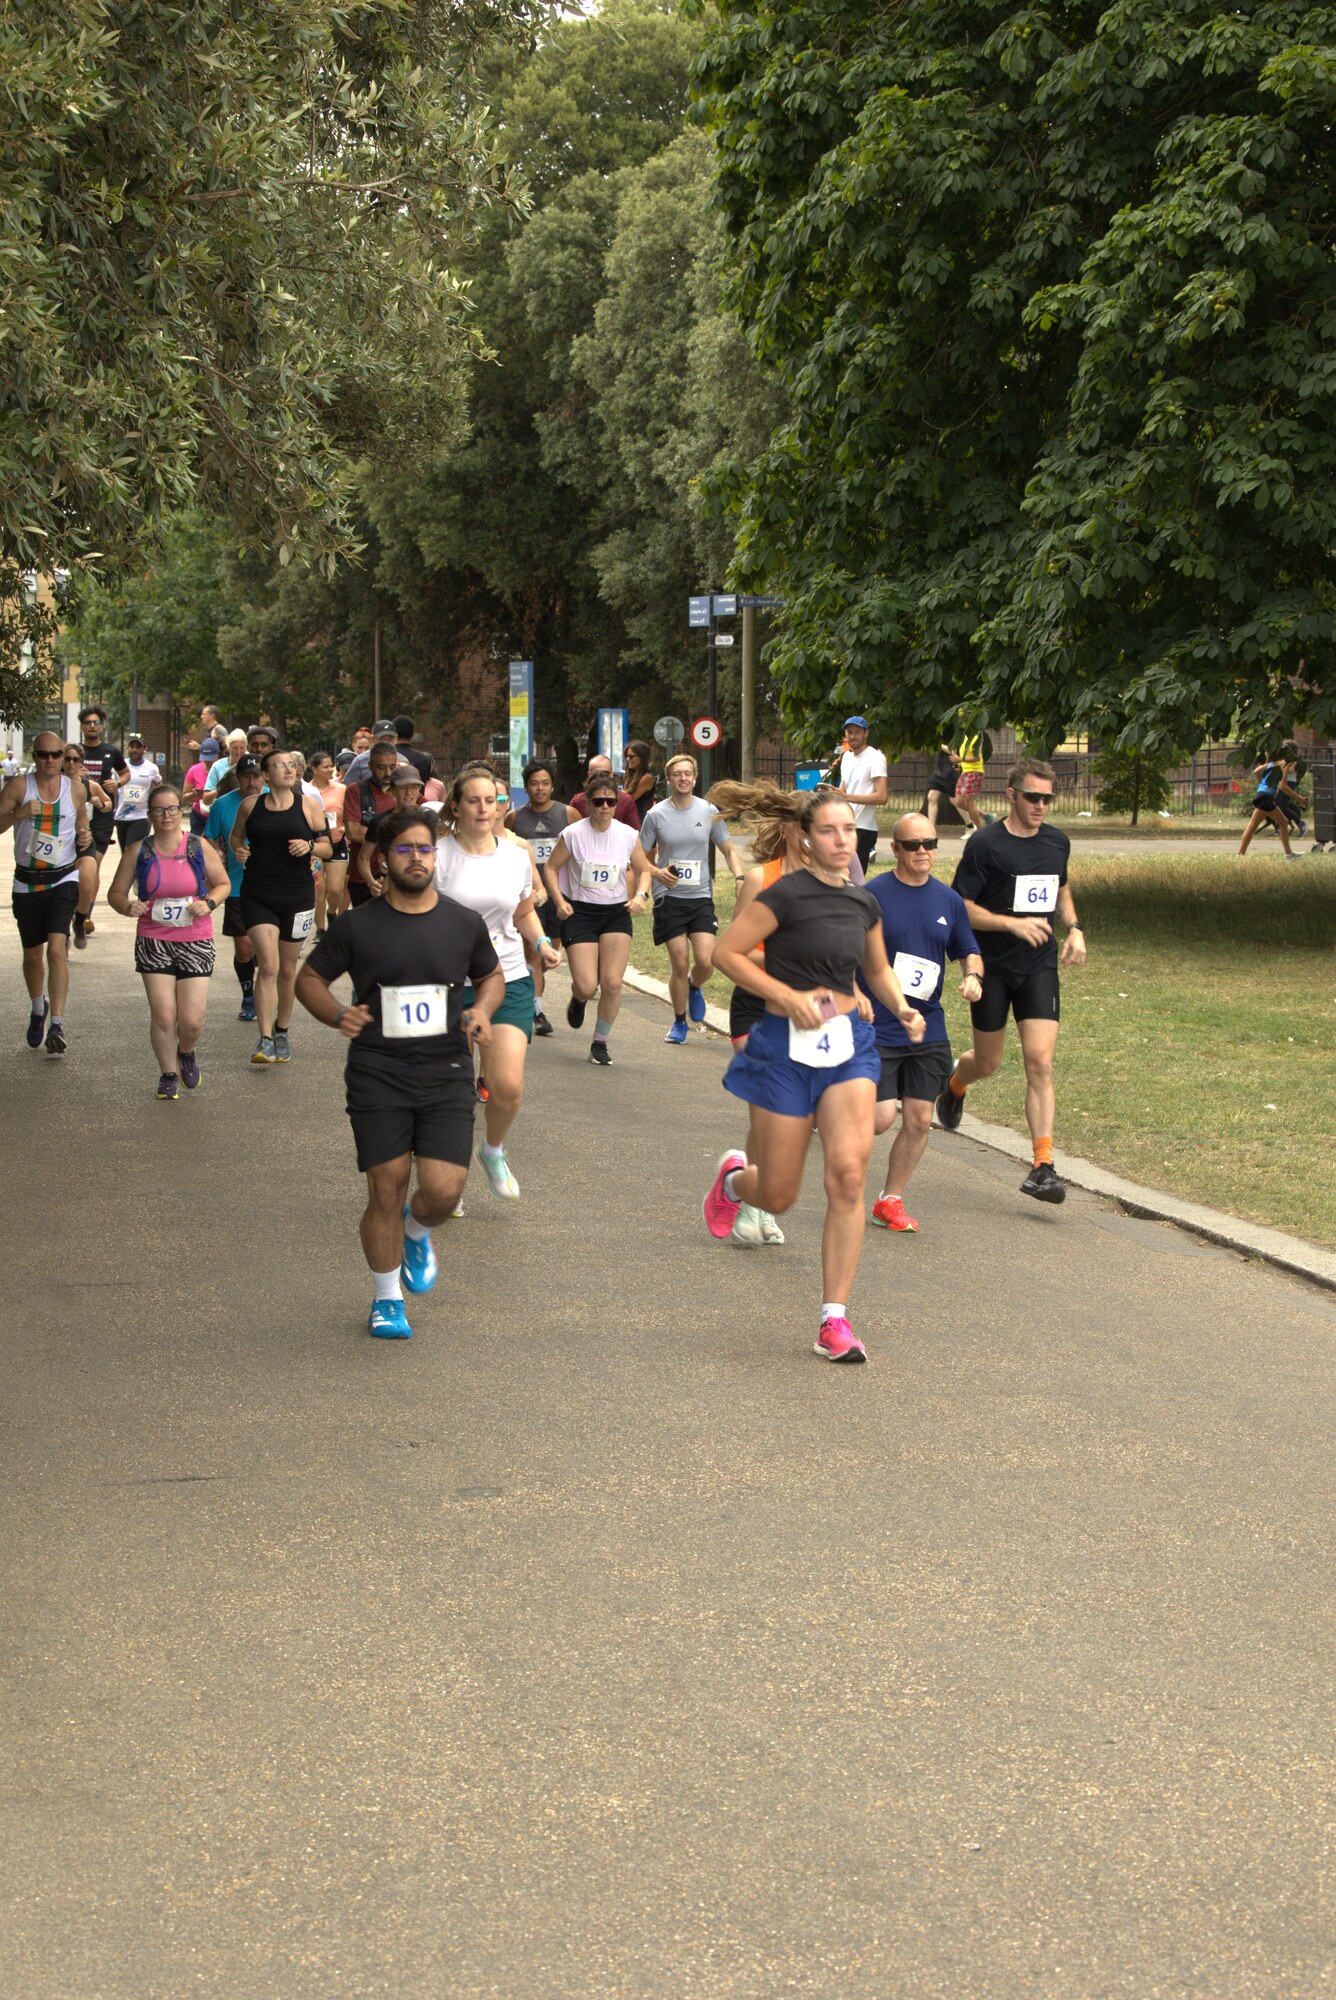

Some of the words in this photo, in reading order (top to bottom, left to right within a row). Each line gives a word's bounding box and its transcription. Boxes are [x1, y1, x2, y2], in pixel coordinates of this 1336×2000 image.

[702, 727, 711, 739] 5
[129, 790, 140, 799] 56
[35, 840, 53, 855] 79
[536, 846, 552, 858] 33
[592, 870, 609, 882] 19
[677, 867, 692, 879] 50
[1027, 887, 1048, 903] 64
[163, 906, 183, 920] 37
[911, 970, 923, 987] 3
[400, 1001, 430, 1025] 10
[816, 1033, 831, 1054] 4
